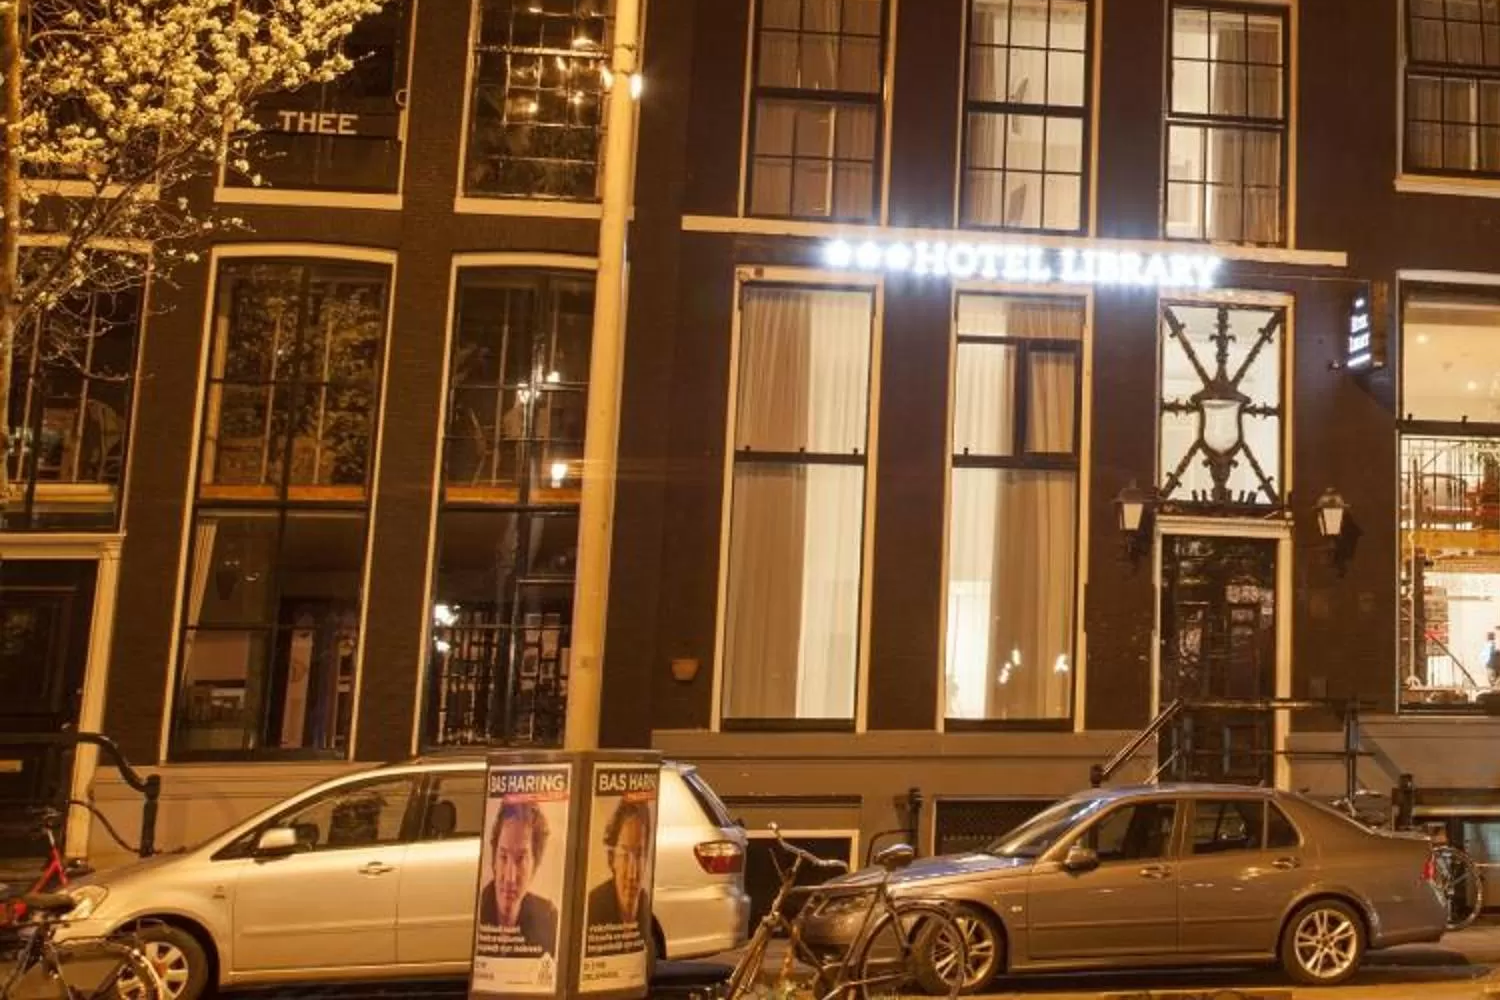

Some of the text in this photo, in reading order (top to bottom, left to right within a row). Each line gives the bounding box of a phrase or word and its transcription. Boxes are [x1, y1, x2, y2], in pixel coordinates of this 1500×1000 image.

[277, 110, 359, 135] THEE
[913, 242, 1221, 287] HOTEL LIBRARY
[489, 773, 565, 793] BAS HARING
[600, 773, 627, 791] BAS
